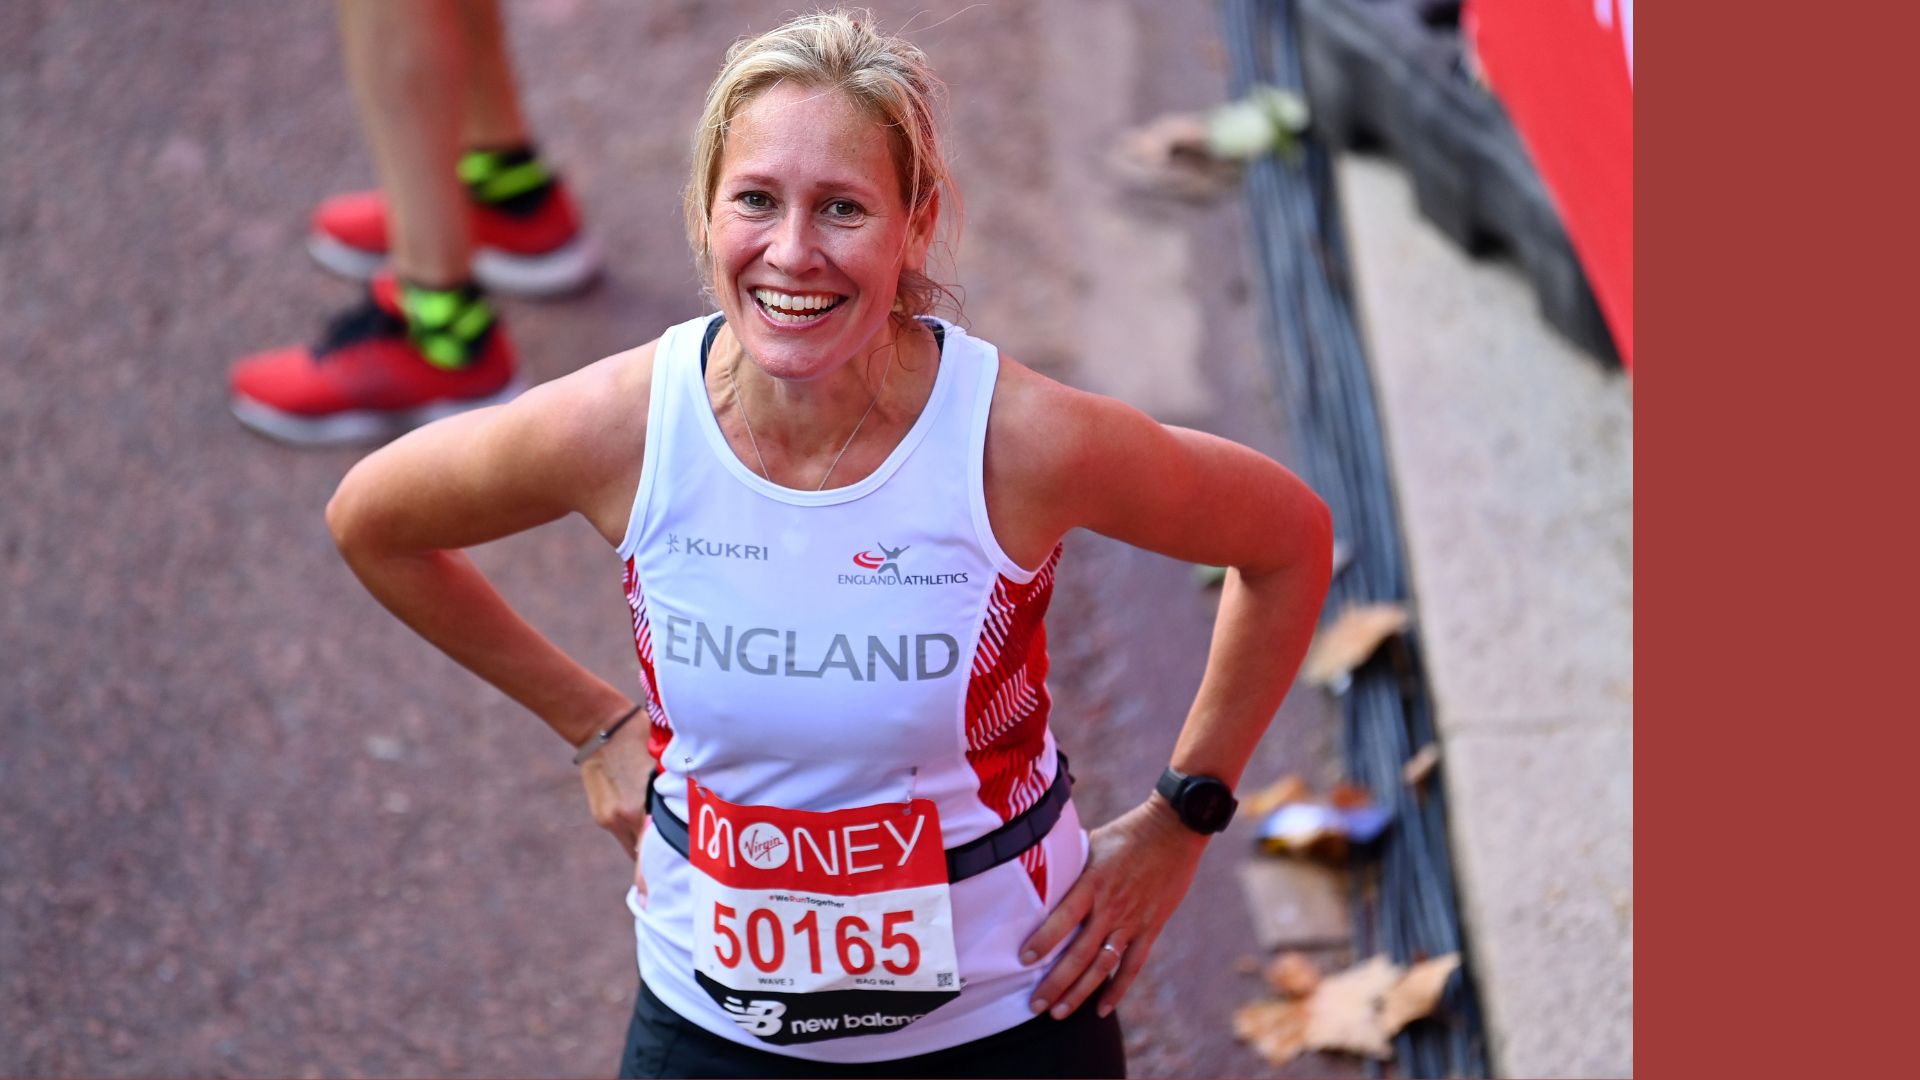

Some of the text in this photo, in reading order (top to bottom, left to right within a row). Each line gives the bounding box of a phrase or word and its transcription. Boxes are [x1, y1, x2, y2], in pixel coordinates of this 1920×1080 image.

[685, 537, 769, 562] KUKRI
[837, 572, 969, 586] ENGLAND ATHLETICS
[664, 614, 960, 682] ENGLAND
[743, 829, 785, 862] Virgin
[713, 900, 921, 977] 50165
[757, 977, 786, 986] WAVE
[790, 1012, 928, 1035] new balan
